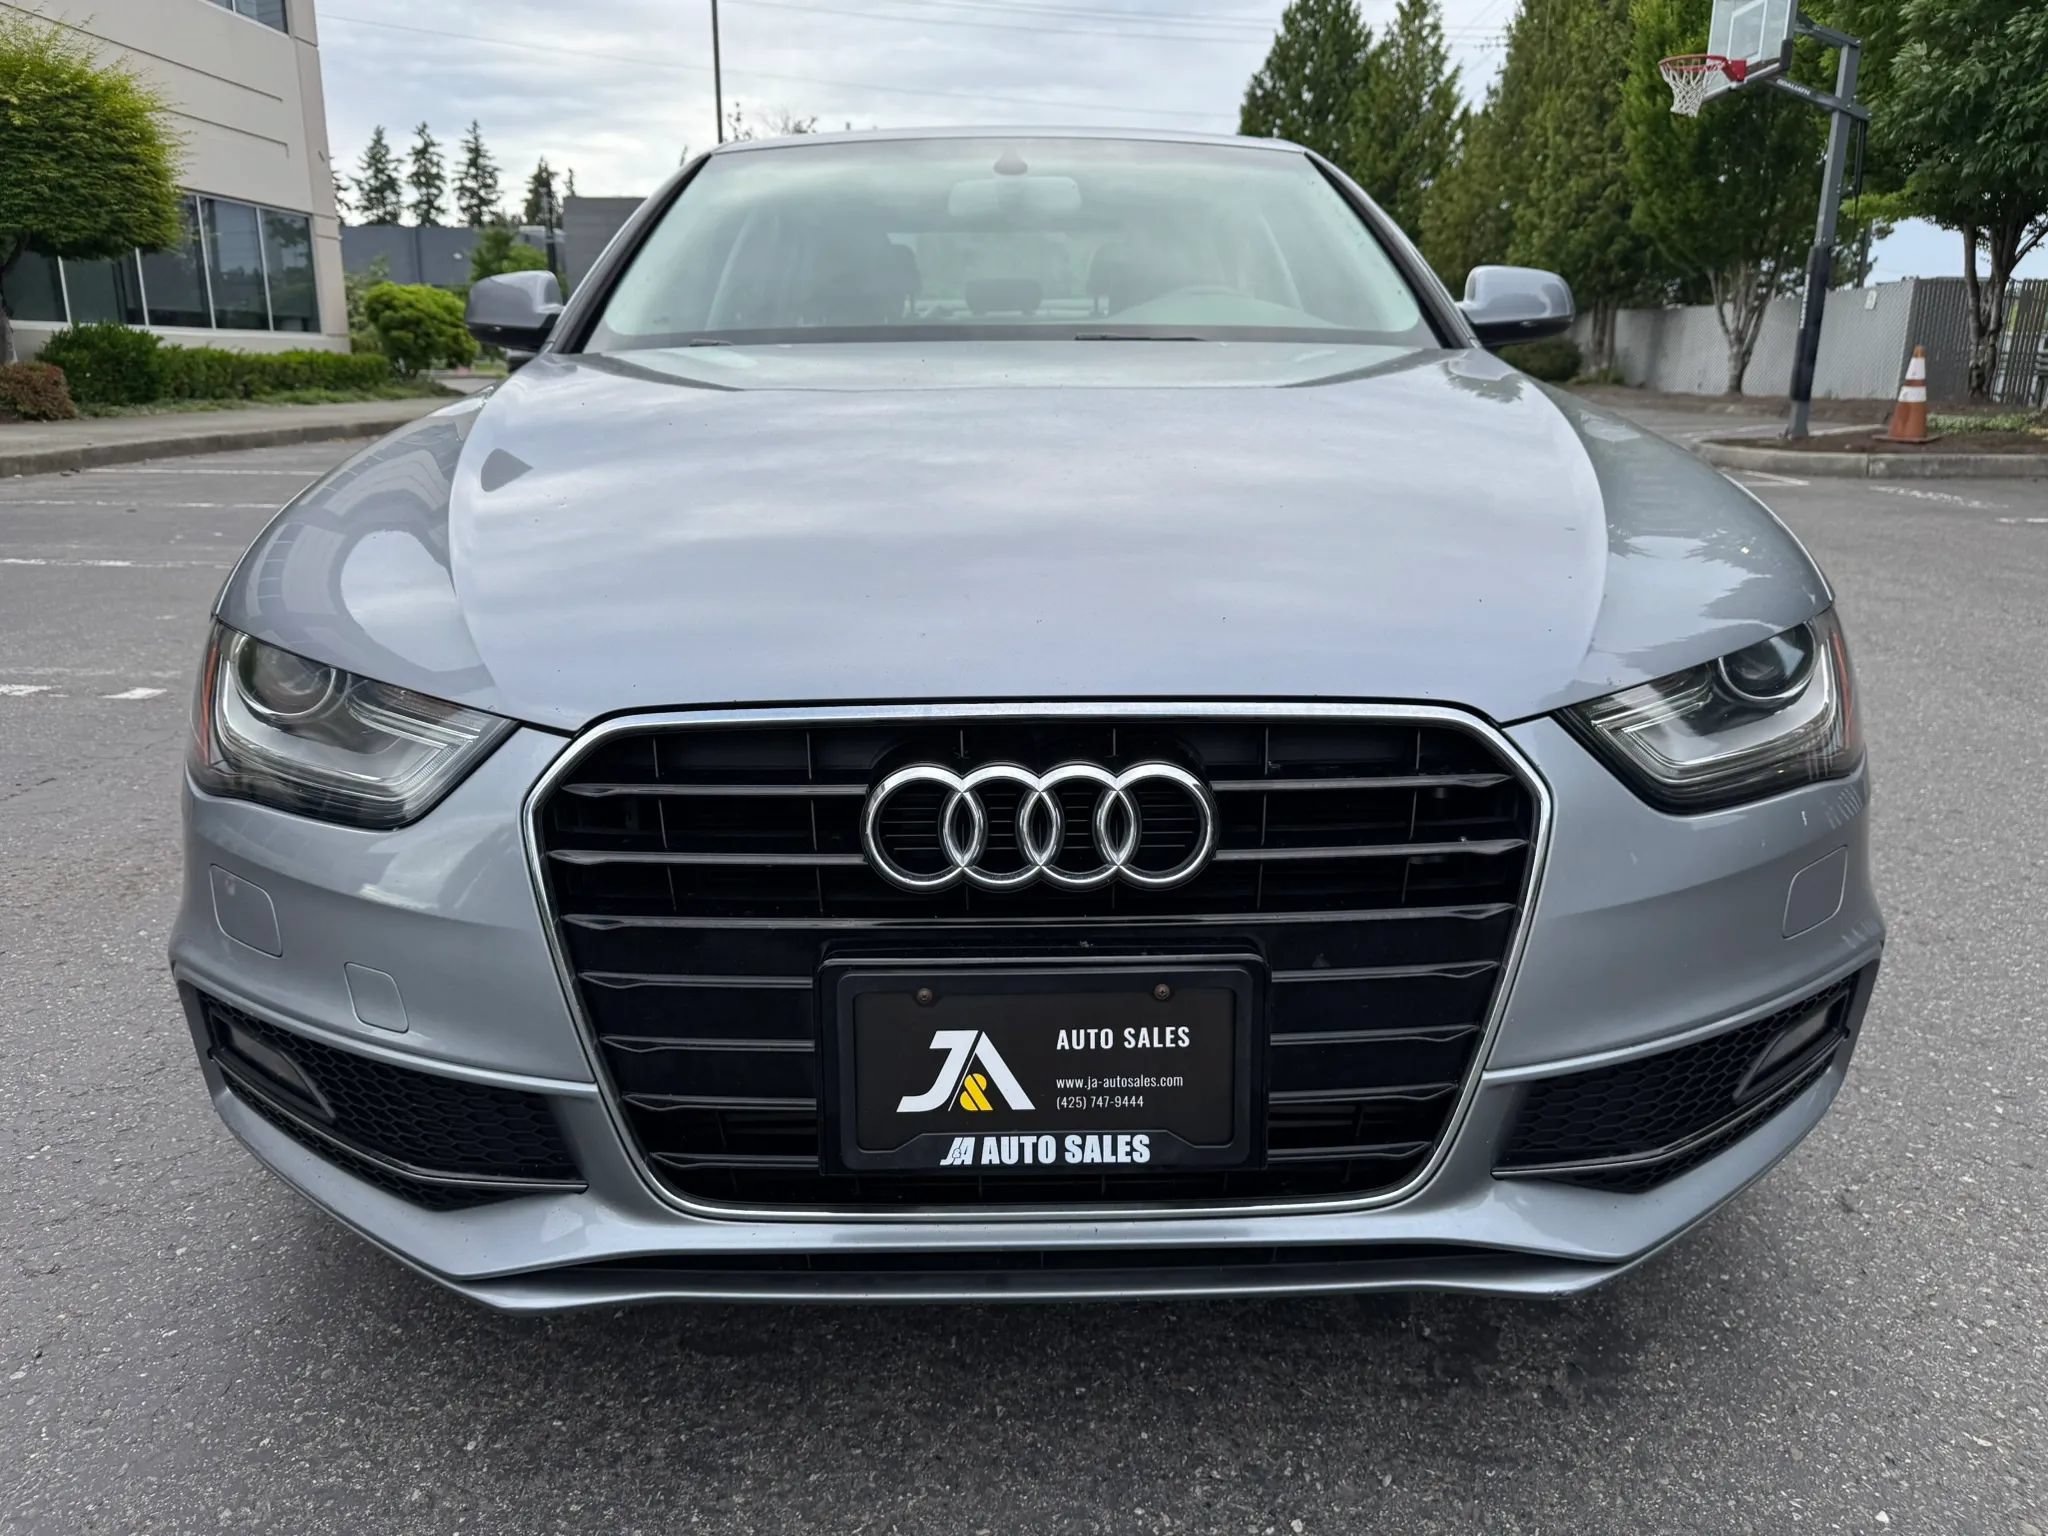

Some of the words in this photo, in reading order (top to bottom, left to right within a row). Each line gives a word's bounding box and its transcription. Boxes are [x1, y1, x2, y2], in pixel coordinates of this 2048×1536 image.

[1056, 1028, 1114, 1050] AUTO
[1123, 1026, 1190, 1049] SALES
[1056, 1074, 1184, 1090] www.ja-autosales.com
[1056, 1096, 1087, 1110] (425)
[1090, 1095, 1144, 1109] 747-9444
[980, 1134, 1057, 1165] AUTO
[1064, 1134, 1151, 1164] SALES
